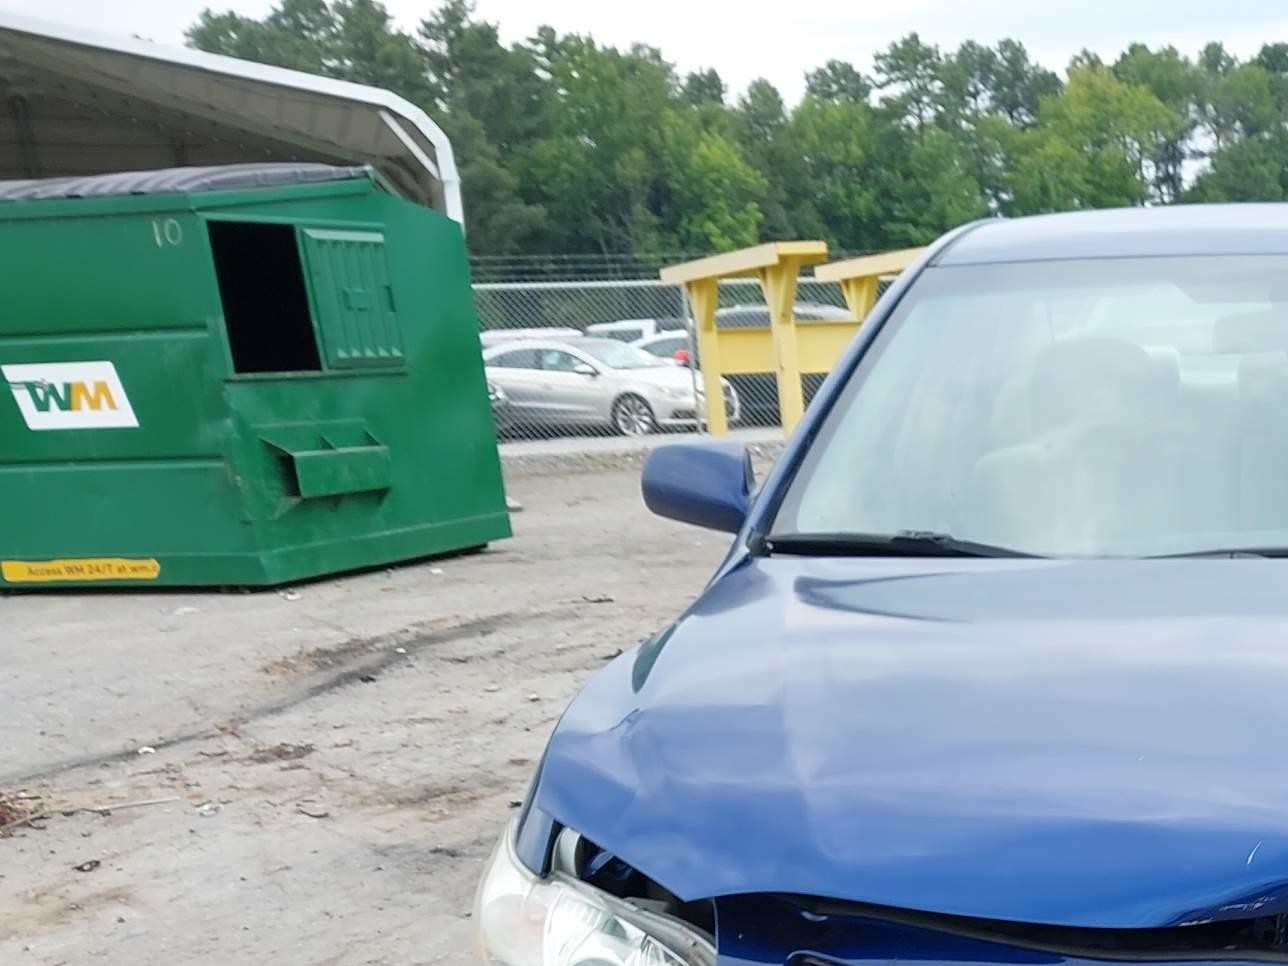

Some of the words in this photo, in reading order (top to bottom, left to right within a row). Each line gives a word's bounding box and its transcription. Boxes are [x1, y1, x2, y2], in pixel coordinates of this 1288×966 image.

[152, 218, 182, 248] 10
[24, 380, 118, 412] WM
[27, 565, 62, 576] Access
[64, 565, 85, 576] WM
[87, 563, 113, 575] 24/7
[117, 564, 126, 574] at
